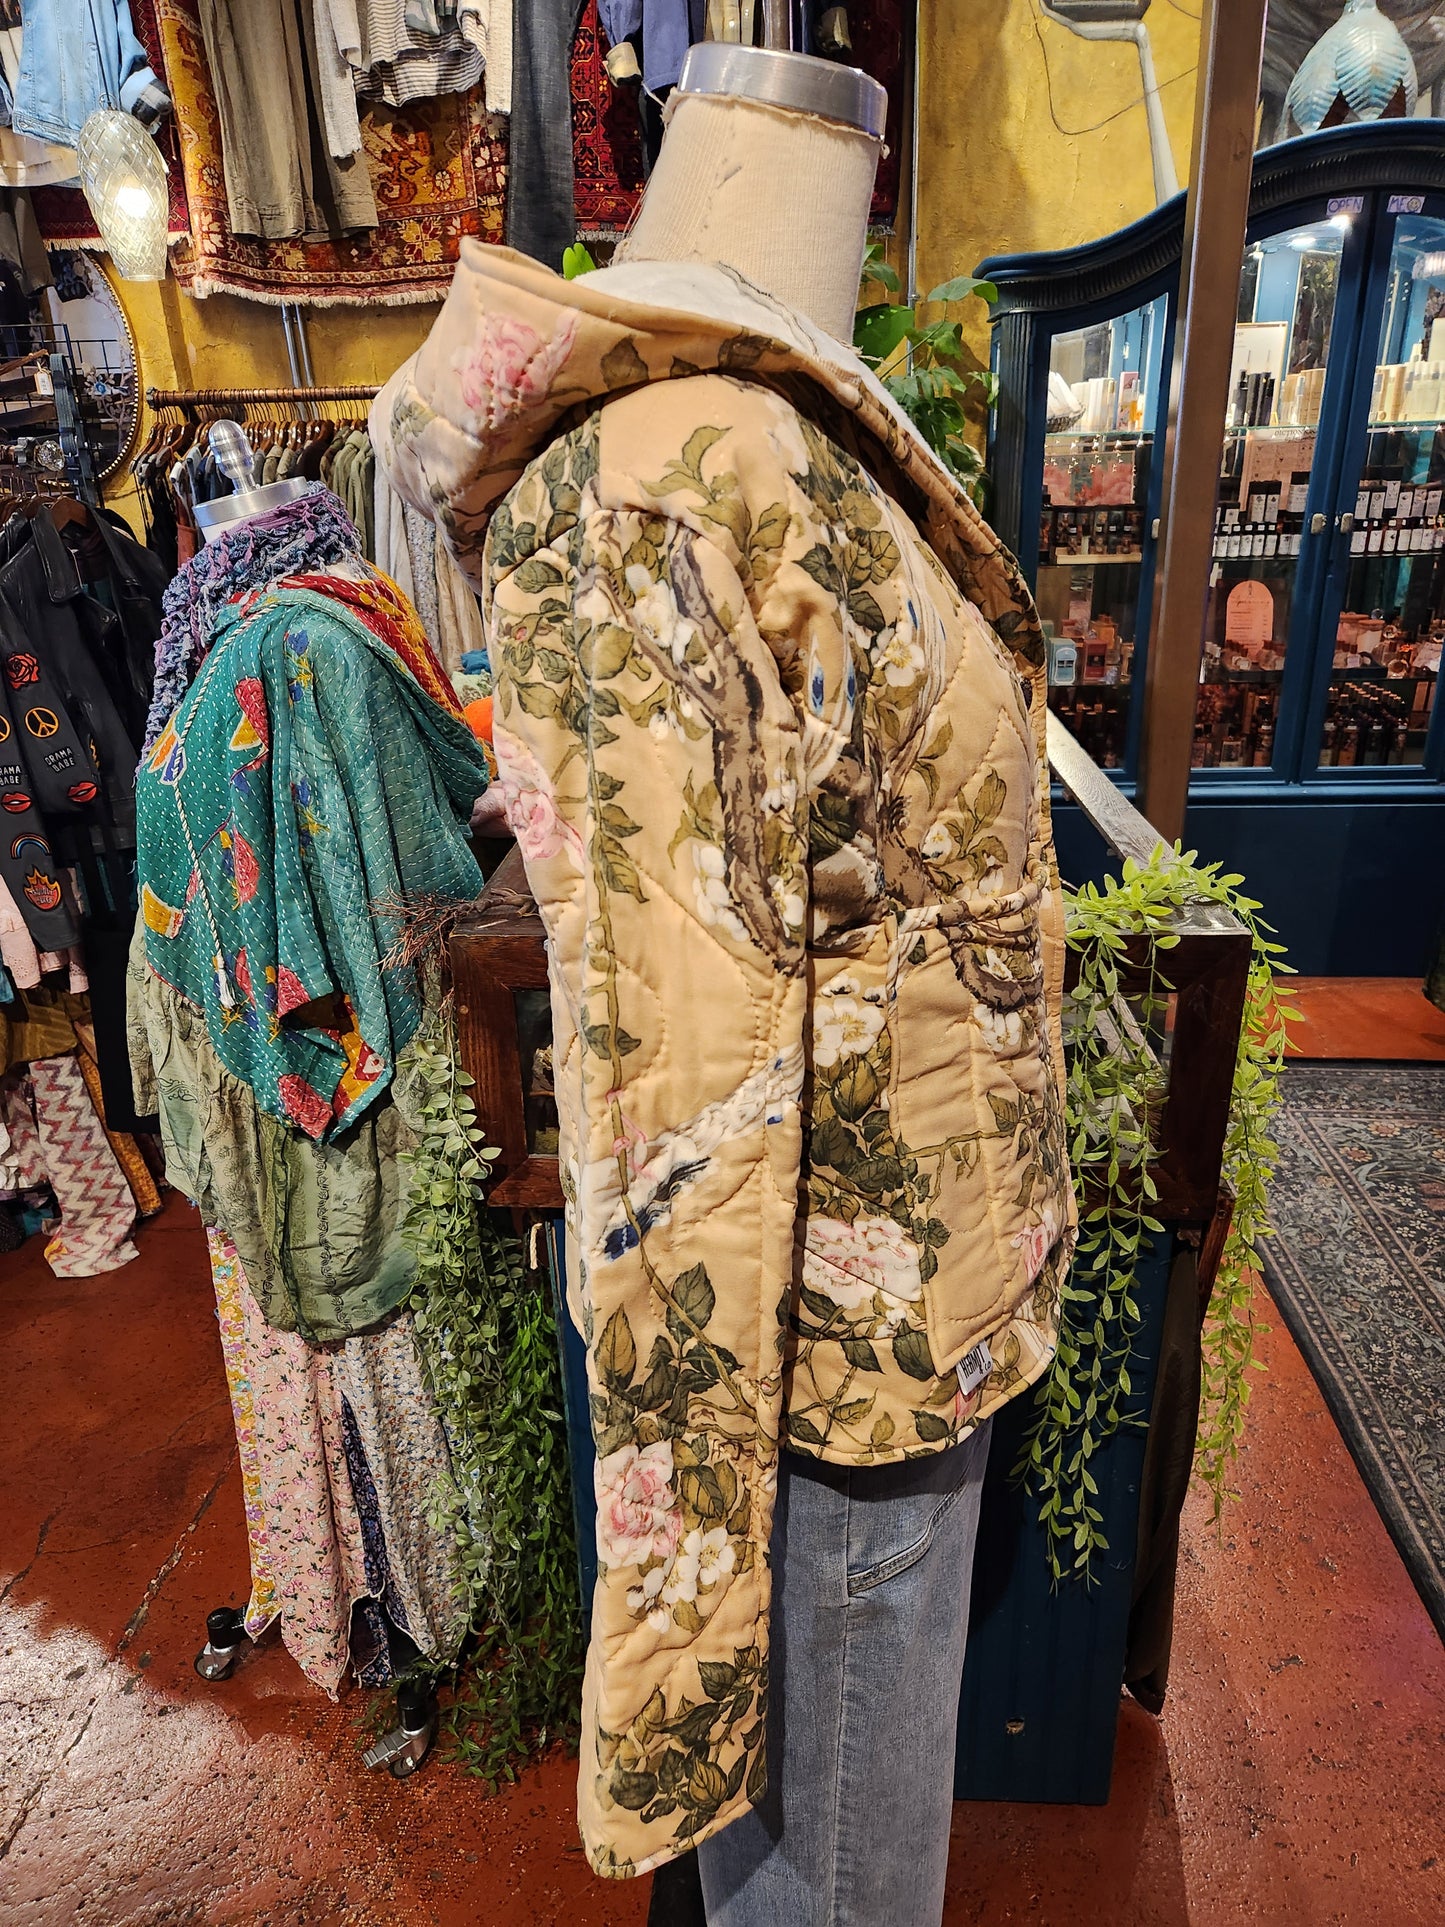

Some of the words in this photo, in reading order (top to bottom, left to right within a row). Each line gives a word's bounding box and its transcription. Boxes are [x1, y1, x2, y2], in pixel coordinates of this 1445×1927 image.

[1329, 198, 1361, 212] OPEN
[44, 748, 73, 766] DRAMA
[51, 757, 75, 772] BABE
[0, 765, 21, 775] RAMA
[959, 1345, 985, 1378] HERMIT
